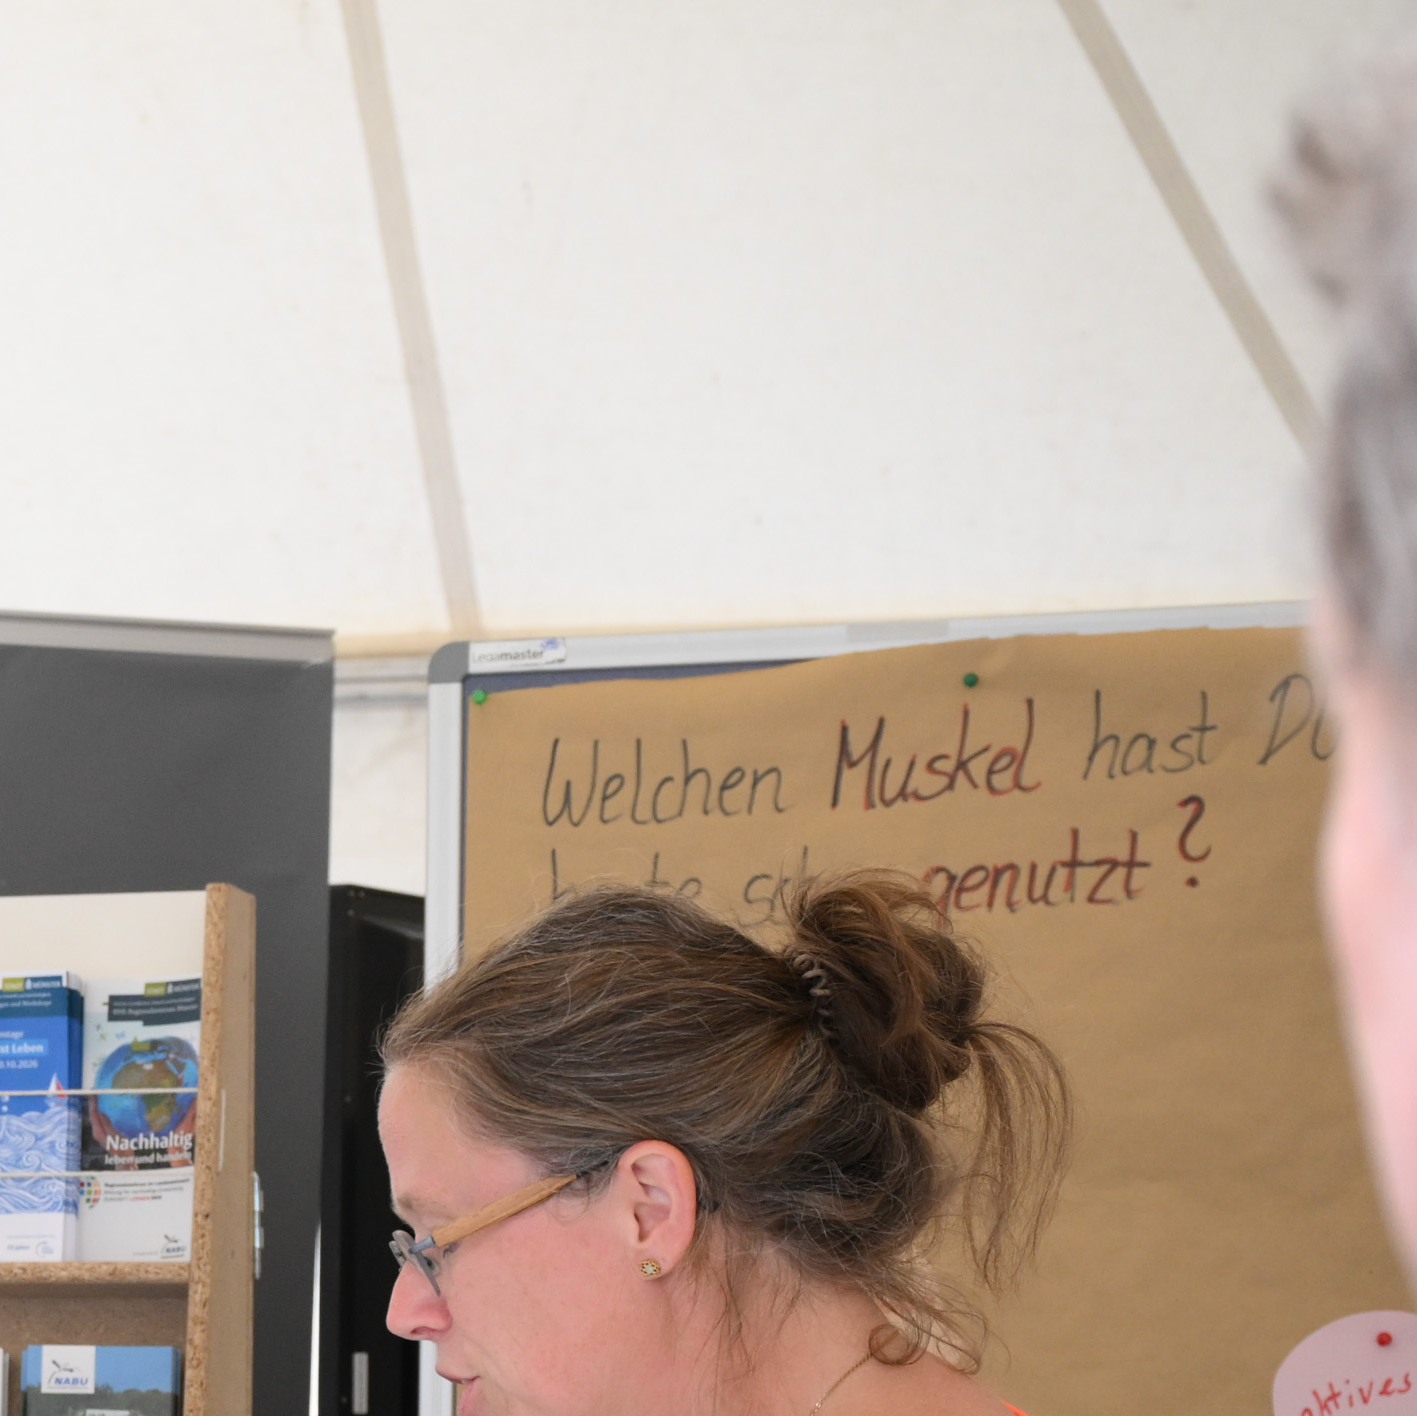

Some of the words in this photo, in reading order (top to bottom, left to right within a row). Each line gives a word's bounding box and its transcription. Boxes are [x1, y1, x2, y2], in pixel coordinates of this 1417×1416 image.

[541, 736, 791, 829] Welchen
[828, 696, 1043, 812] Muskel
[1082, 689, 1218, 783] hast
[11, 1042, 44, 1054] Leben
[105, 1130, 193, 1151] Nachhaltig
[104, 1154, 135, 1166] leben
[135, 1153, 156, 1165] und
[54, 1377, 89, 1386] NABU
